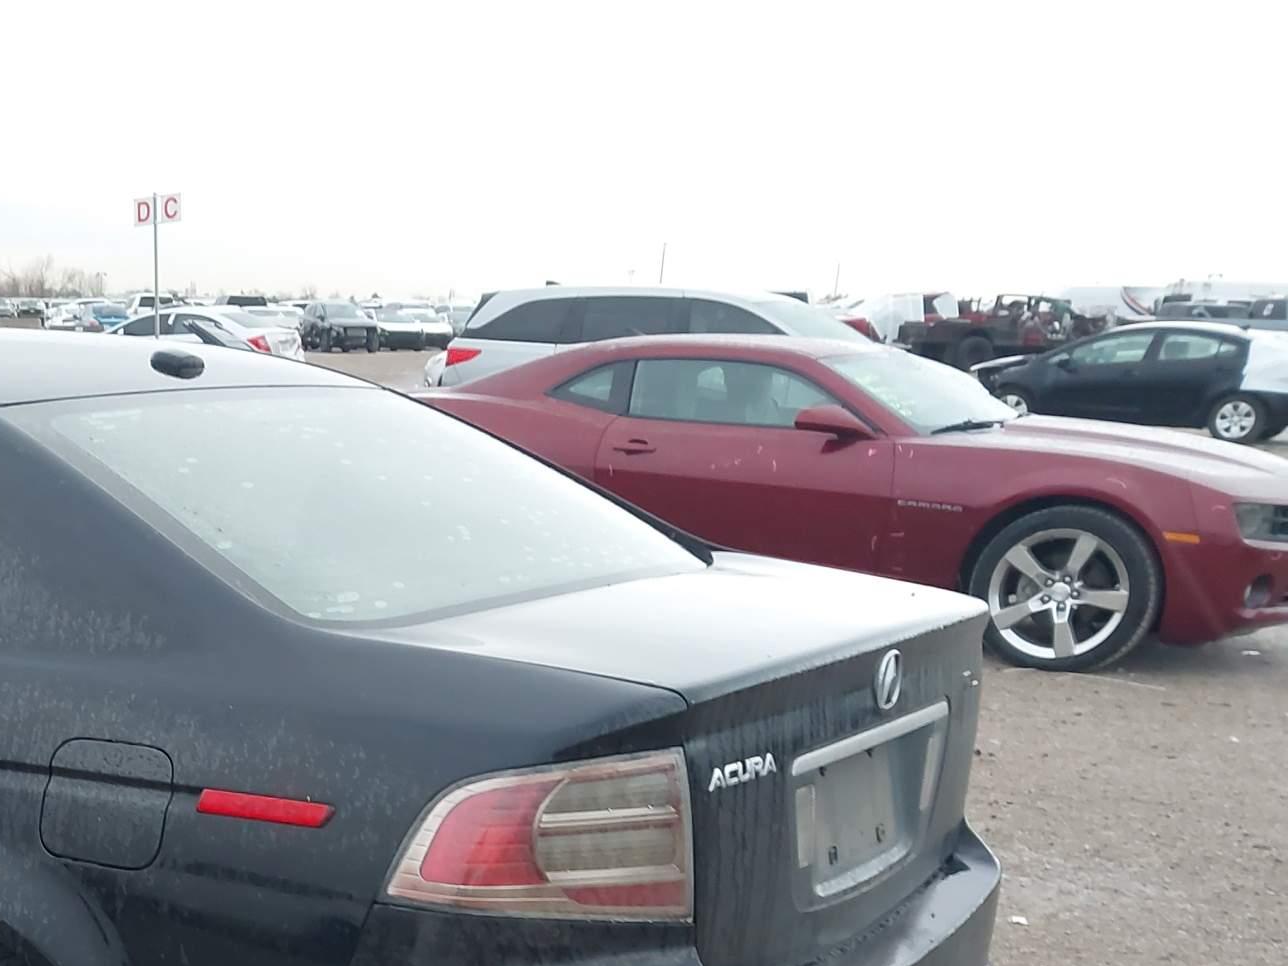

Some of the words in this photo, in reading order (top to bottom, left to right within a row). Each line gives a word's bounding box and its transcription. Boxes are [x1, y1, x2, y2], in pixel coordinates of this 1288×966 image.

[137, 201, 151, 222] D
[164, 196, 178, 219] C
[708, 752, 777, 792] ACURA
